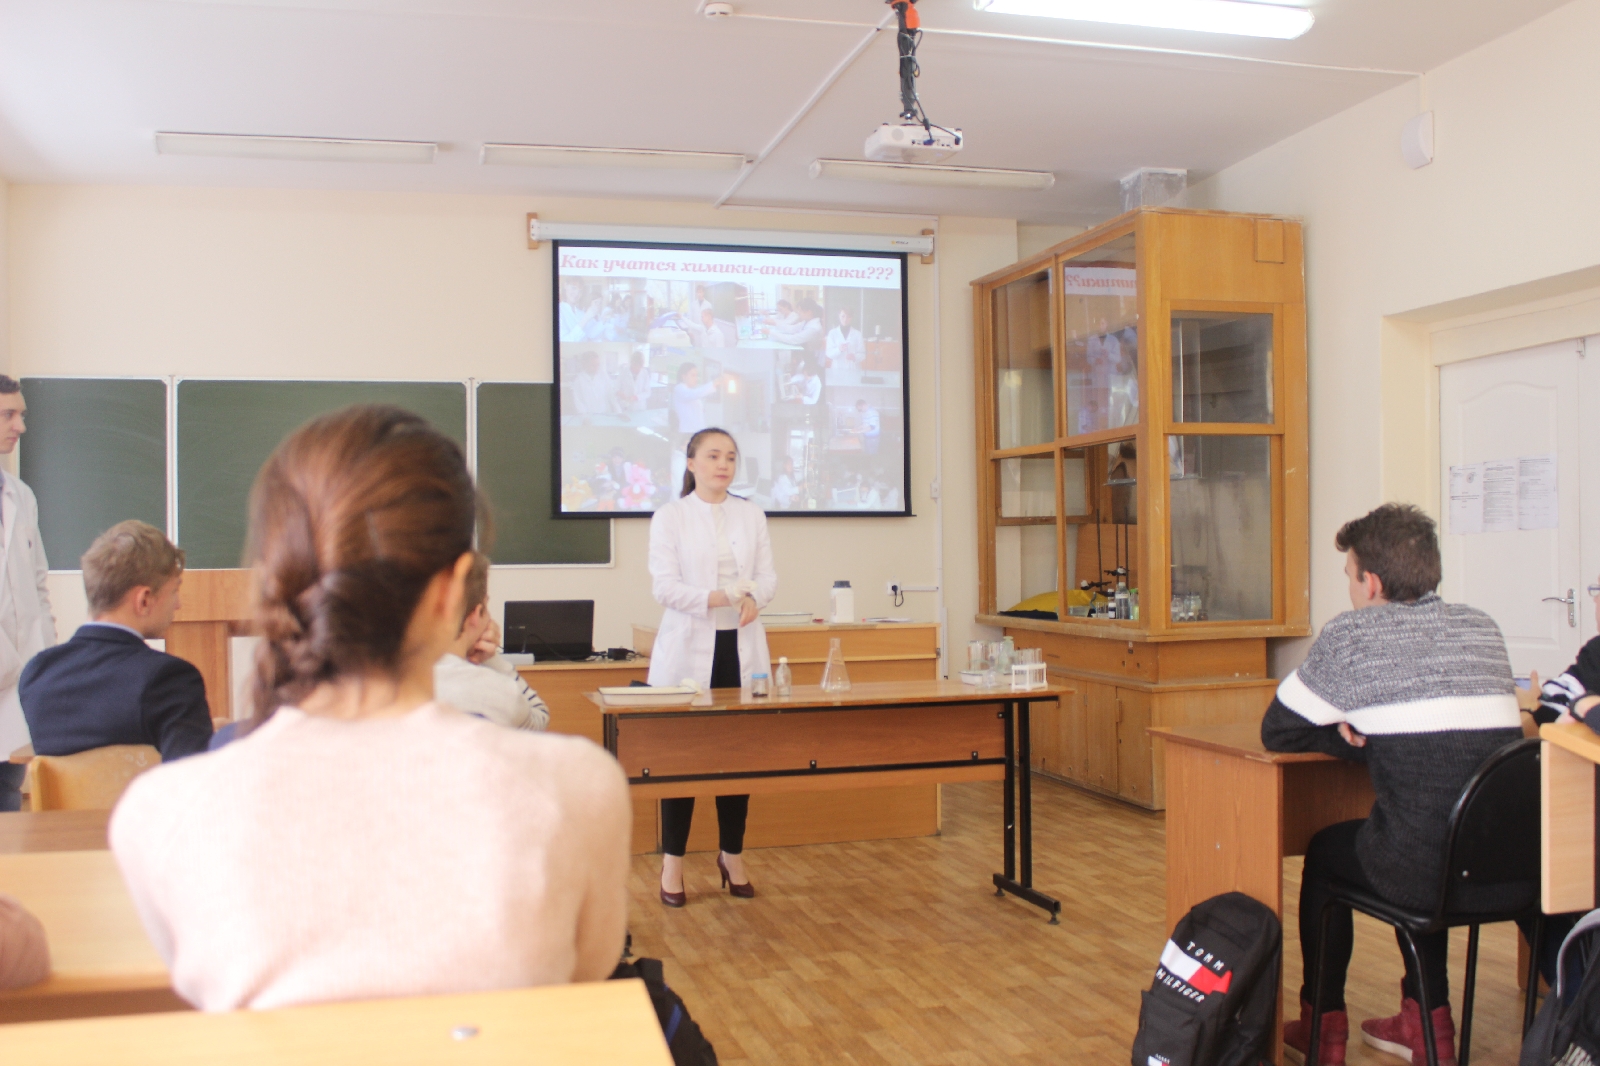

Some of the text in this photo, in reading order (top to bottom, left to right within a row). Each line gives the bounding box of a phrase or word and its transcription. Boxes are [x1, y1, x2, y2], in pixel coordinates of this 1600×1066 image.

[560, 254, 894, 281] Как учатся химики-аналитики???
[1186, 941, 1225, 971] TOMM
[1156, 968, 1205, 1003] HILFIGER
